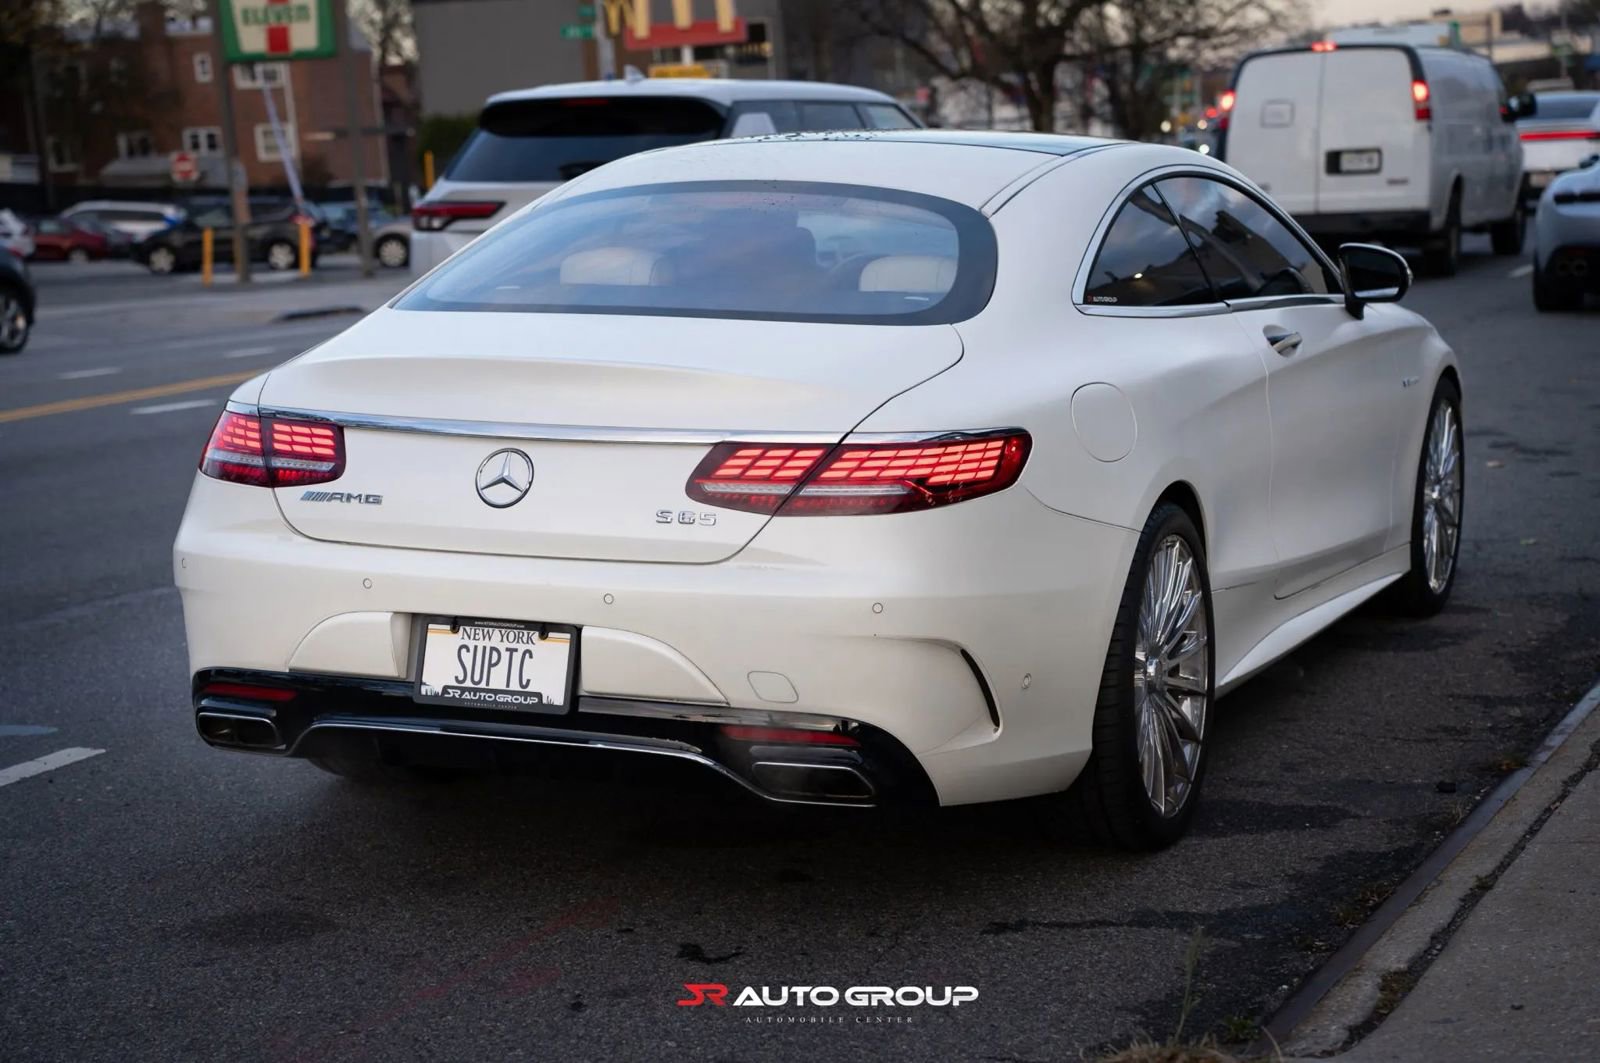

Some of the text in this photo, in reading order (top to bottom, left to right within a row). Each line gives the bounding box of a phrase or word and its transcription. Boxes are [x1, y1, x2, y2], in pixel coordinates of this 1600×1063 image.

[325, 491, 384, 506] AMG
[461, 627, 536, 645] NEW YORK
[454, 644, 533, 689] SUPTC
[461, 692, 495, 701] AUTO
[496, 694, 538, 704] GROUP
